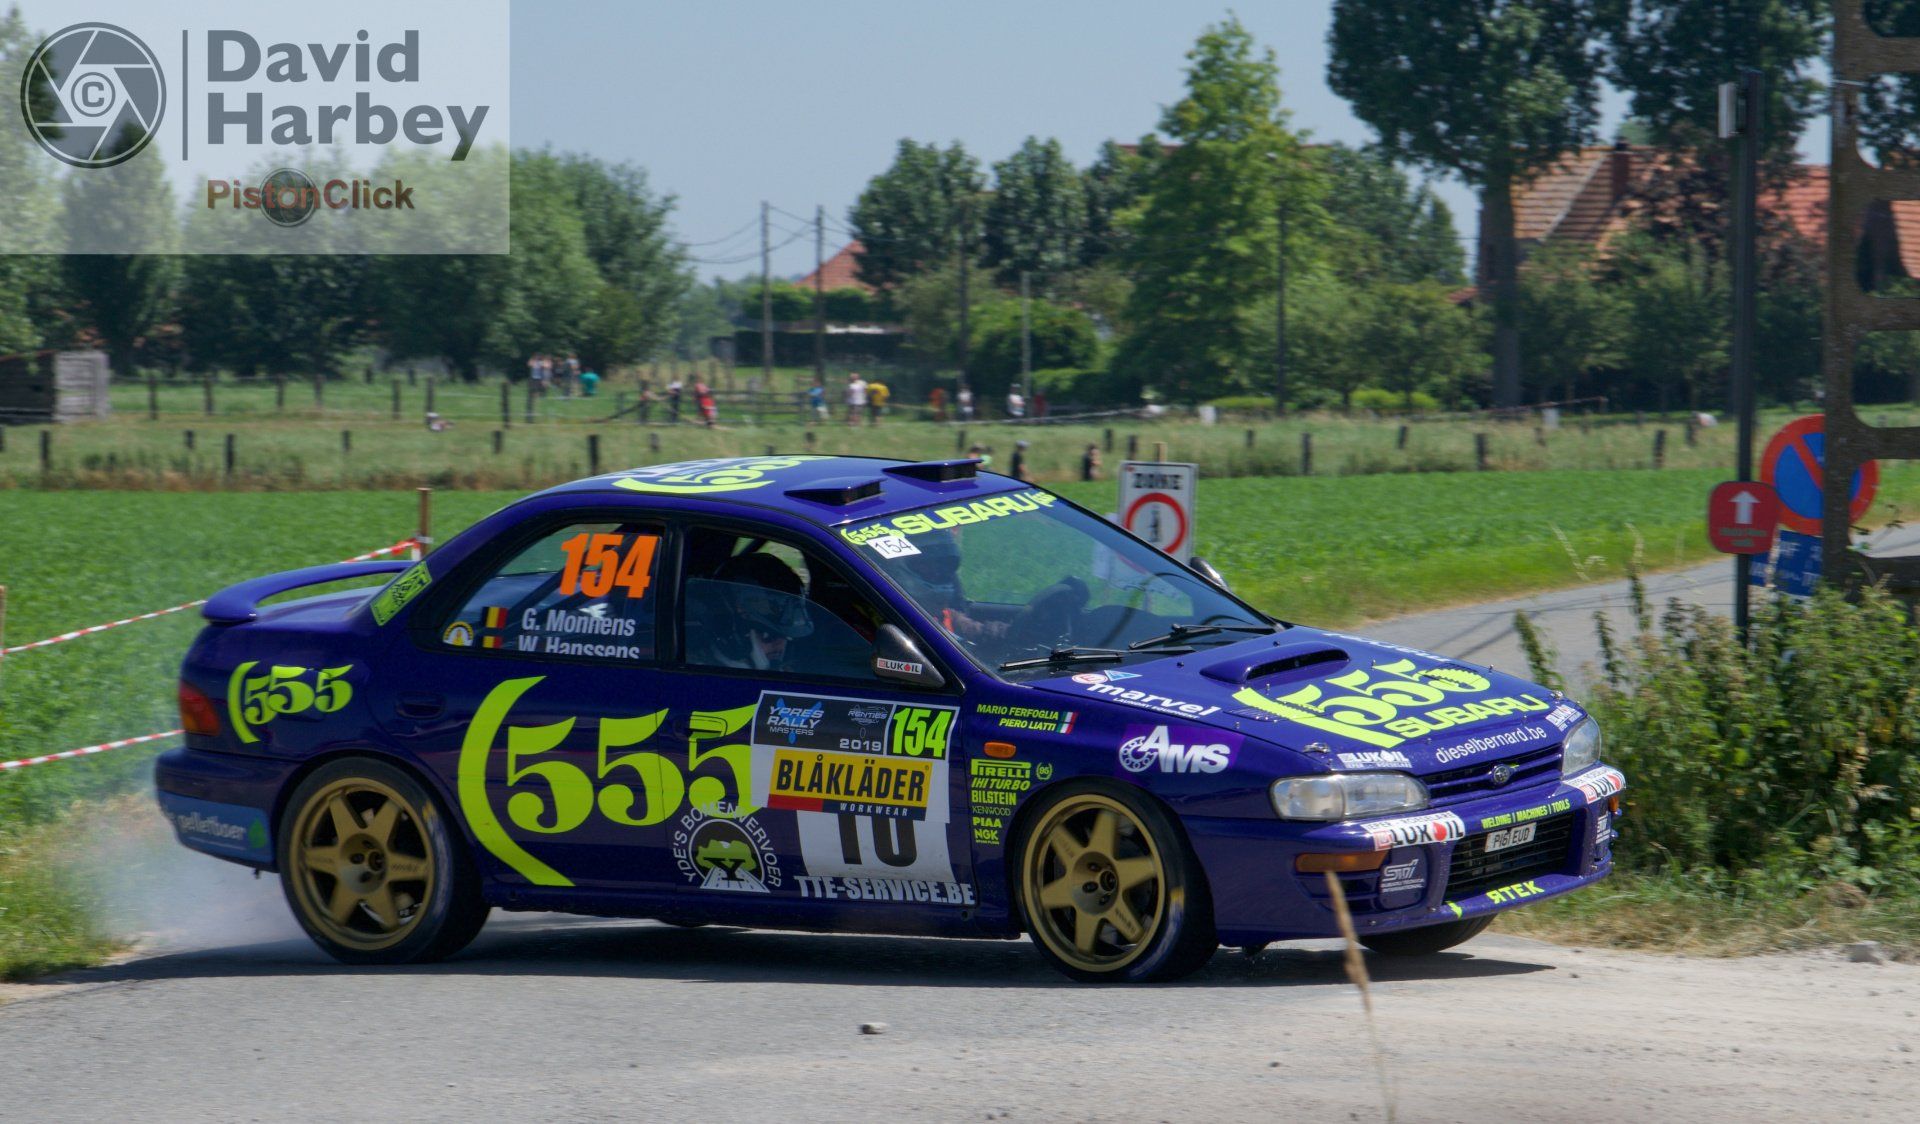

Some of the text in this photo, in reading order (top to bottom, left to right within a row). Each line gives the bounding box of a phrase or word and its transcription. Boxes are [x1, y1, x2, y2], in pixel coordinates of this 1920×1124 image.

[891, 493, 1039, 534] SUBARU
[875, 538, 913, 554] 154
[560, 532, 658, 598] 154
[522, 608, 540, 631] G.
[1087, 683, 1221, 716] marvel
[769, 705, 825, 719] YPRES
[976, 704, 1059, 720] MARIO FERFOGLIA
[1384, 694, 1550, 739] SUBARU
[766, 715, 821, 730] RALLY
[999, 718, 1028, 728] PIERO
[769, 726, 815, 736] MASTERS
[892, 708, 951, 759] 154
[839, 738, 882, 751] 2019
[1435, 726, 1547, 764] dieselbernard.be
[971, 759, 1031, 779] PIRELLI
[776, 754, 925, 803] BLÅKLÄDER
[971, 778, 1031, 791] IHI TURBO
[971, 790, 1017, 805] BILSTEIN
[840, 803, 908, 817] WORKWEAR
[972, 806, 1011, 816] KENWOOD
[1481, 798, 1570, 829] WELDING MACHINES TOOLS
[972, 817, 1002, 828] PIAA
[974, 828, 999, 840] NGK
[1390, 819, 1464, 846] LUKOIL
[793, 875, 976, 905] TTE-SERVICE.BE
